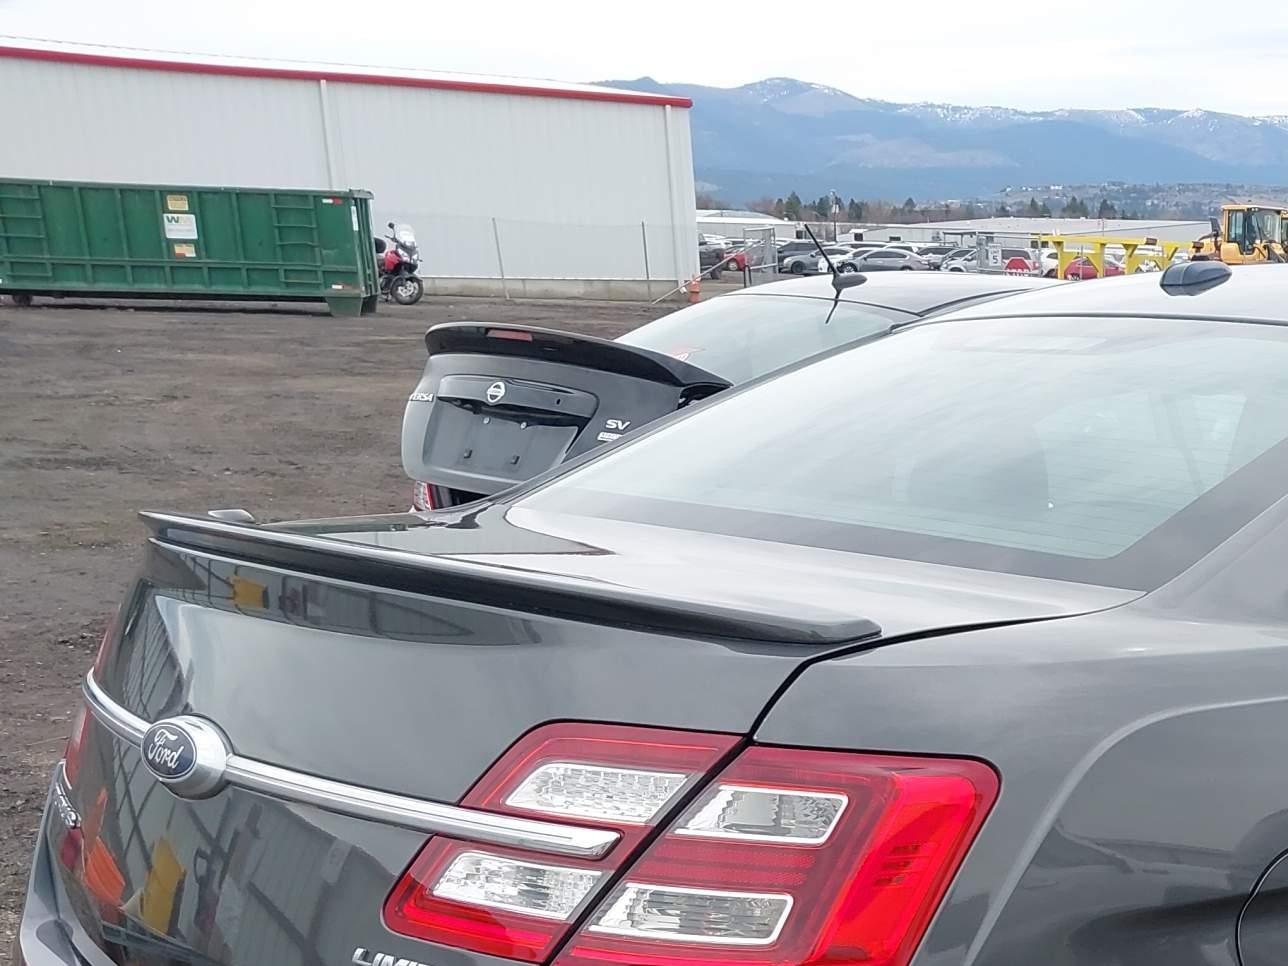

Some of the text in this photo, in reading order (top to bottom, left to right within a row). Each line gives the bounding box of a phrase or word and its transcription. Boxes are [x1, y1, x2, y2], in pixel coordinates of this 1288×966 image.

[992, 255, 999, 264] 5
[605, 419, 631, 431] SV
[148, 729, 185, 769] Ford
